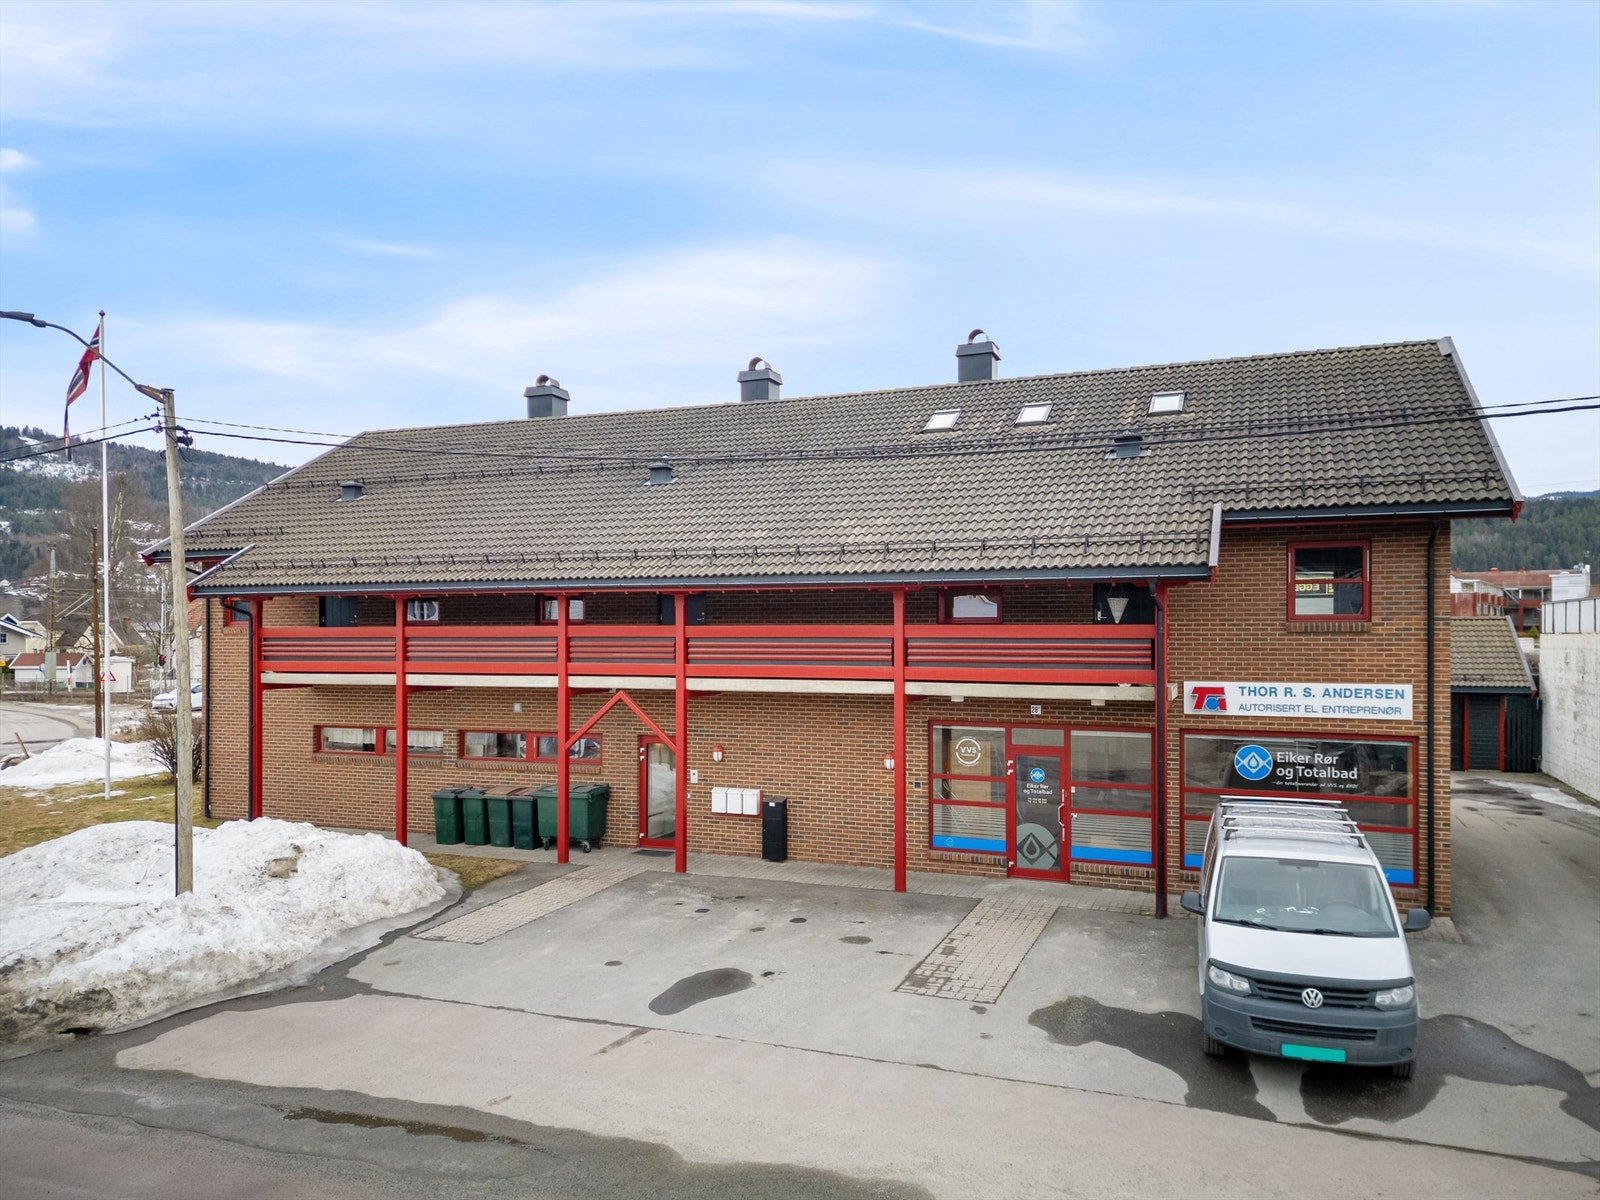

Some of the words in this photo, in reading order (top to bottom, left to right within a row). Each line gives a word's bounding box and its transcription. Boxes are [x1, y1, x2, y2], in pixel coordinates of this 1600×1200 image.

[1238, 686, 1278, 697] THOR
[1284, 687, 1297, 698] R.
[1303, 687, 1316, 698] S.
[1322, 687, 1405, 699] ANDERSEN
[1238, 703, 1301, 713] AUTORISERT
[1304, 704, 1318, 713] EL.
[1322, 705, 1402, 715] ENTREPRENØR
[1276, 751, 1311, 763] Eiker
[1314, 753, 1339, 765] Rør
[1276, 767, 1294, 780] og
[1295, 765, 1358, 779] Totalbad
